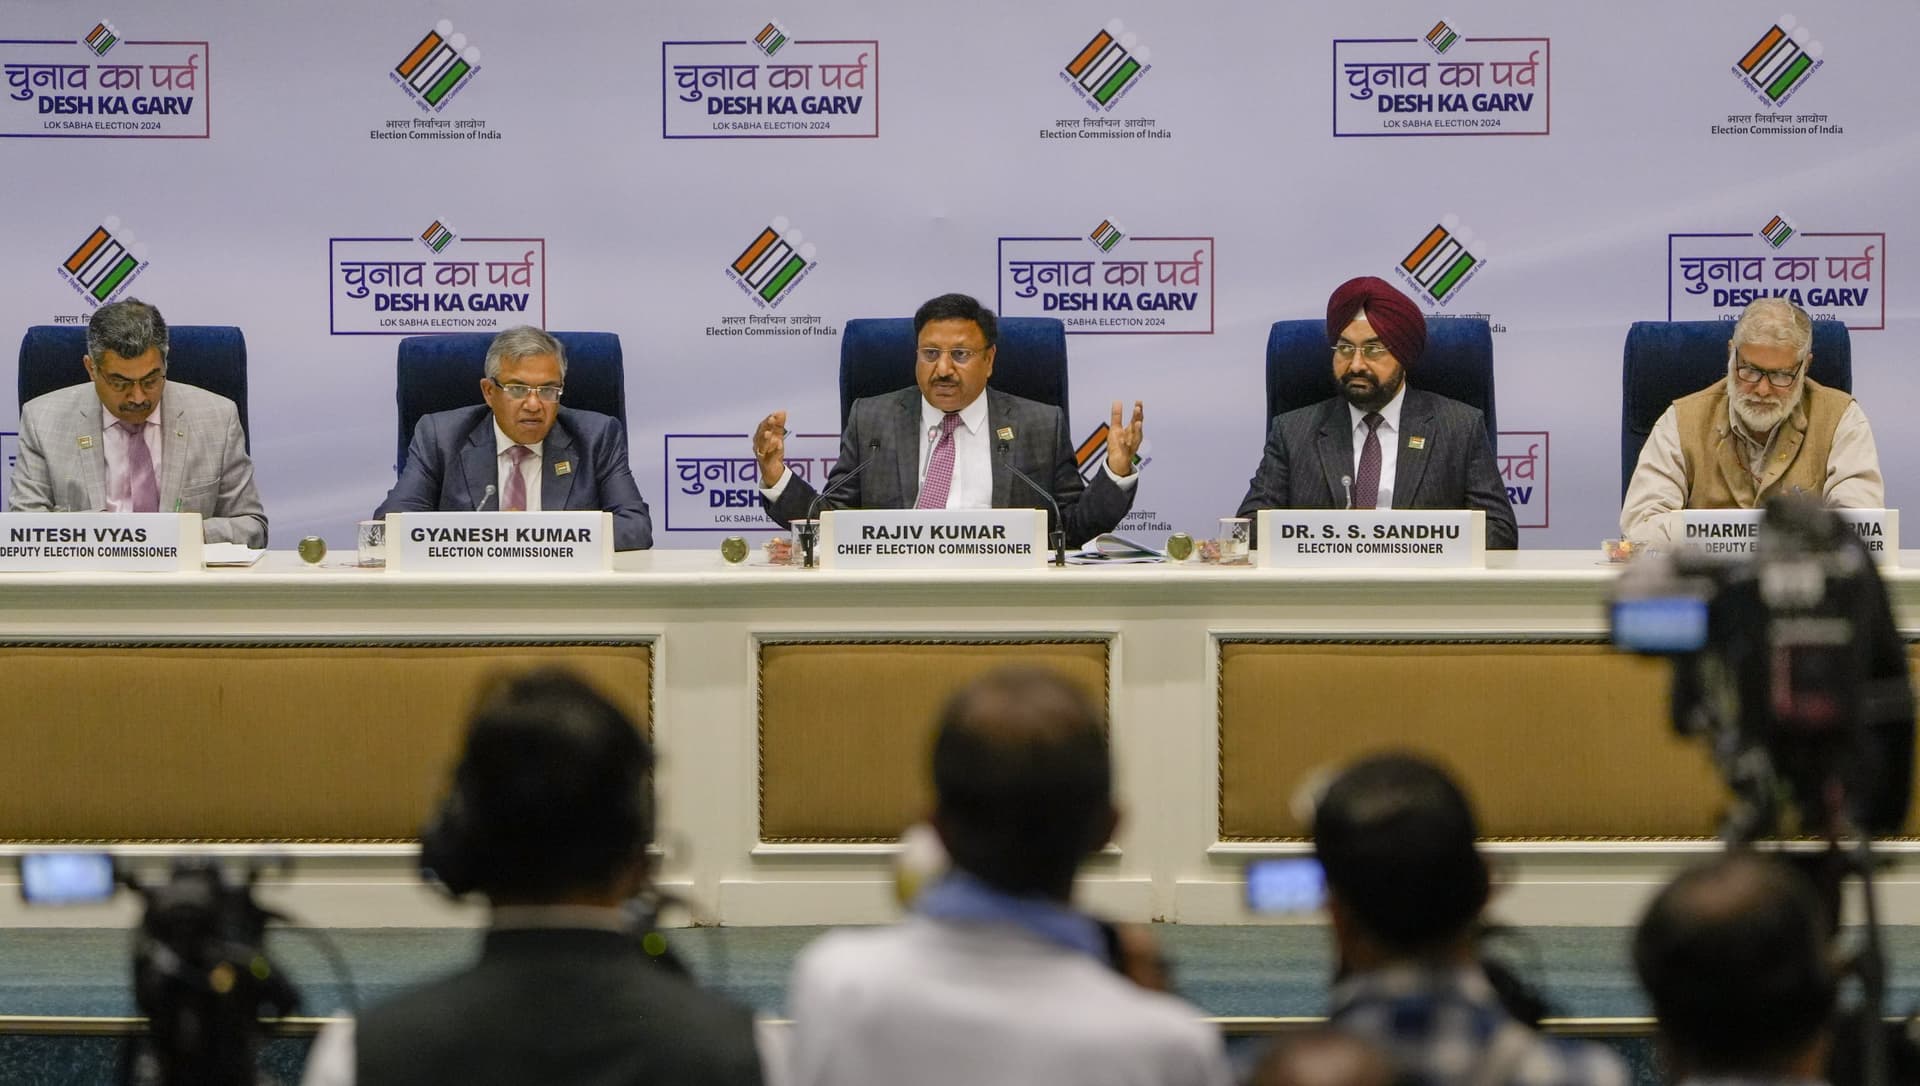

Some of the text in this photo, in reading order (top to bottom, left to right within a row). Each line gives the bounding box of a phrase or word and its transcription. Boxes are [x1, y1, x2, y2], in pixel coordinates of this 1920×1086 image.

[4, 54, 198, 100] चुनाव का पर्व
[674, 52, 868, 102] चुनाव का पर्व
[1344, 50, 1540, 100] चुनाव का पर्व
[38, 96, 193, 114] DESH KA GARV
[708, 96, 862, 114] DESH KA GARV
[1378, 93, 1534, 112] DESH KA GARV
[386, 118, 485, 128] भारत निर्वाचन आयोग
[1056, 117, 1155, 128] भारत निर्वाचन आयोग
[1384, 118, 1500, 128] LOK SABHA ELECTION 2024
[1728, 112, 1828, 123] भारत निर्वाचन आयोग
[96, 122, 138, 130] ELECTION
[141, 122, 161, 130] 2024
[712, 122, 730, 130] LOK
[732, 122, 762, 130] SABHA
[1712, 125, 1843, 134] Election Commission of India
[370, 130, 502, 139] Election Commission of India
[1040, 129, 1172, 138] Election Commission of India
[340, 250, 534, 298] चुनाव का पर्व
[1009, 250, 1204, 298] चुनाव का पर्व
[1680, 245, 1874, 294] चुनाव का पर्व
[374, 294, 529, 312] DESH KA GARV
[1043, 292, 1198, 311] DESH KA GARV
[1807, 288, 1868, 306] GARV
[722, 314, 821, 324] भारत निर्वाचन आयोग
[706, 326, 837, 336] Election Commission of India
[676, 458, 758, 494] चुनाव
[710, 490, 762, 508] DESH
[1505, 486, 1532, 504] RV
[862, 526, 1006, 540] RAJIV KUMAR
[1138, 522, 1147, 530] of
[1148, 522, 1172, 530] India
[1282, 525, 1460, 538] DR. S. S. SANDHU
[1686, 524, 1758, 538] DHARME
[10, 528, 146, 542] NITESH VYAS
[410, 528, 591, 542] GYANESH KUMAR
[0, 546, 177, 558] DEPUTY ELECTION COMMISSIONER
[429, 547, 574, 558] ELECTION COMMISSIONER
[838, 544, 1030, 554] CHIEF ELECTION COMMISSIONER
[1298, 543, 1443, 554] ELECTION COMMISSIONER
[1706, 542, 1746, 552] DEPUTY
